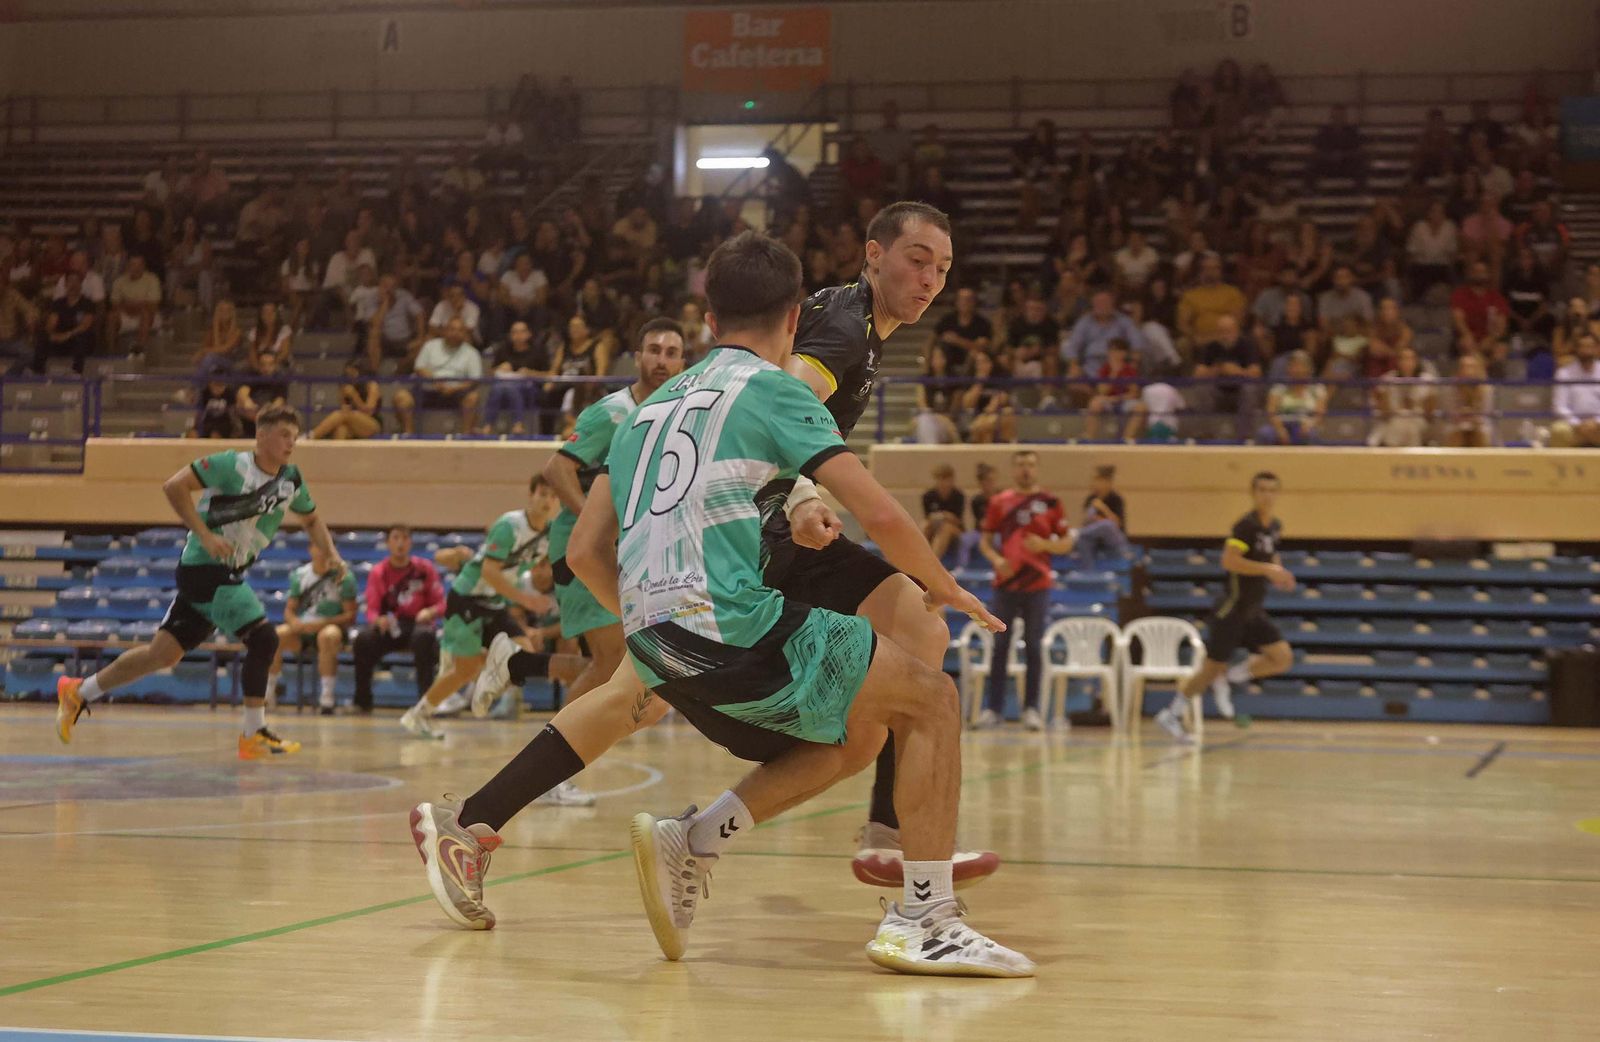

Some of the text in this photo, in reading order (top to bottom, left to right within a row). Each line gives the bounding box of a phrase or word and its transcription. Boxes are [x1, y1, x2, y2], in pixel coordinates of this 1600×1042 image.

[383, 19, 399, 51] A
[732, 12, 784, 37] Bar
[1232, 4, 1249, 37] B
[622, 388, 725, 531] 75
